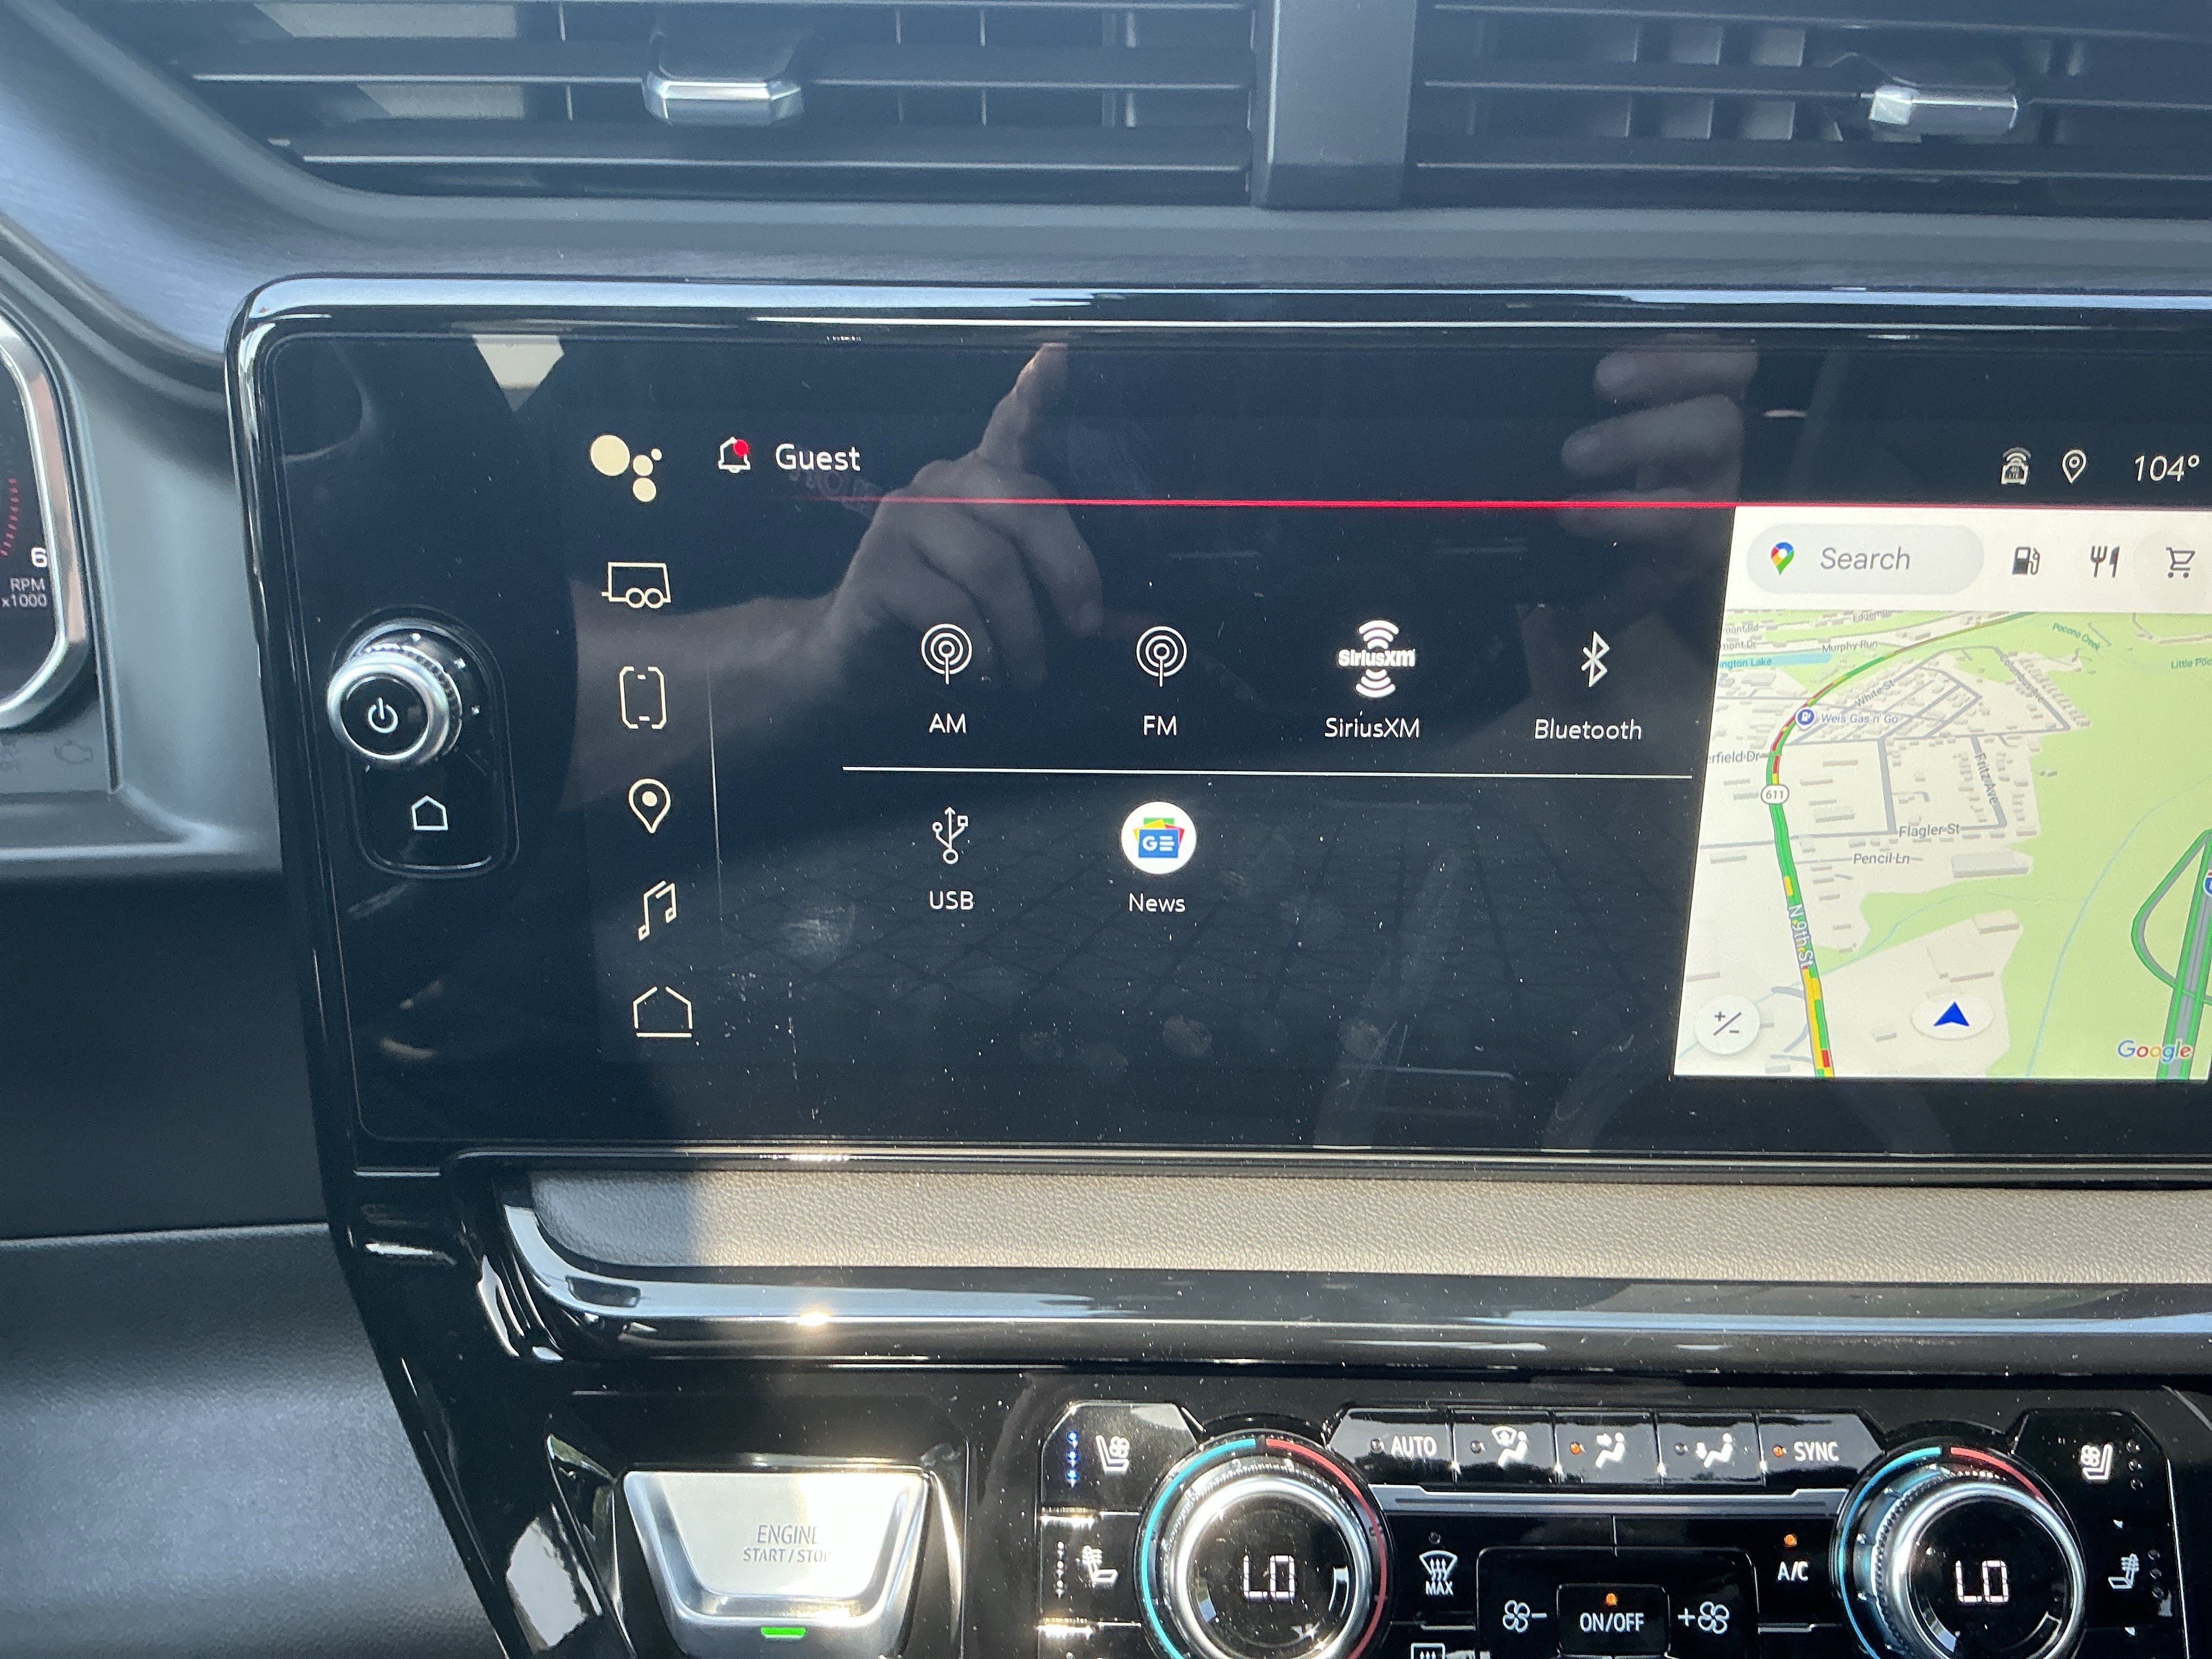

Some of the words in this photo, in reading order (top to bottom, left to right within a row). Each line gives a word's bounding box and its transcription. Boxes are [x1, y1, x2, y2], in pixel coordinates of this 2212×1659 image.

[776, 443, 860, 471] Guest
[2134, 454, 2200, 482] 104°
[31, 547, 48, 567] 6
[1820, 546, 1910, 570] Search
[10, 578, 45, 592] RPM
[1, 593, 47, 607] x1000
[2052, 623, 2081, 639] Pocono
[1822, 641, 1855, 653] Murphy
[1859, 640, 1878, 650] Run
[1751, 657, 1772, 667] Lake
[2171, 659, 2193, 670] Little
[2000, 654, 2032, 690] Columbus
[2032, 688, 2044, 703] Ave
[1854, 686, 1882, 707] White
[1883, 679, 1894, 691] St
[929, 713, 967, 733] AM
[1143, 715, 1177, 736] FM
[1324, 716, 1420, 738] SiriusXM
[1821, 713, 1847, 723] Weis
[1849, 714, 1871, 723] Gas
[1884, 714, 1899, 724] Go
[1534, 718, 1642, 740] Bluetooth
[1746, 750, 1759, 762] Dr
[1975, 752, 1991, 781] Fritz
[1984, 783, 1999, 804] Ave
[1765, 790, 1784, 799] 611
[1899, 824, 1943, 838] Flagler
[1947, 823, 1960, 834] St
[1853, 852, 1893, 865] Pencil
[1895, 853, 1910, 865] Ln
[929, 890, 974, 910] USB
[1128, 893, 1186, 912] News
[1788, 904, 1805, 918] N
[1792, 920, 1810, 947] 9th
[1798, 950, 1814, 969] St
[2118, 1039, 2192, 1063] Google
[1391, 1436, 1437, 1458] AUTO
[1794, 1441, 1839, 1462] SYNC
[1243, 1554, 1295, 1600] LO
[1777, 1561, 1809, 1582] A/C
[1954, 1559, 2009, 1604] LO
[1425, 1581, 1454, 1596] MAX
[1580, 1611, 1645, 1633] ON/OFF
